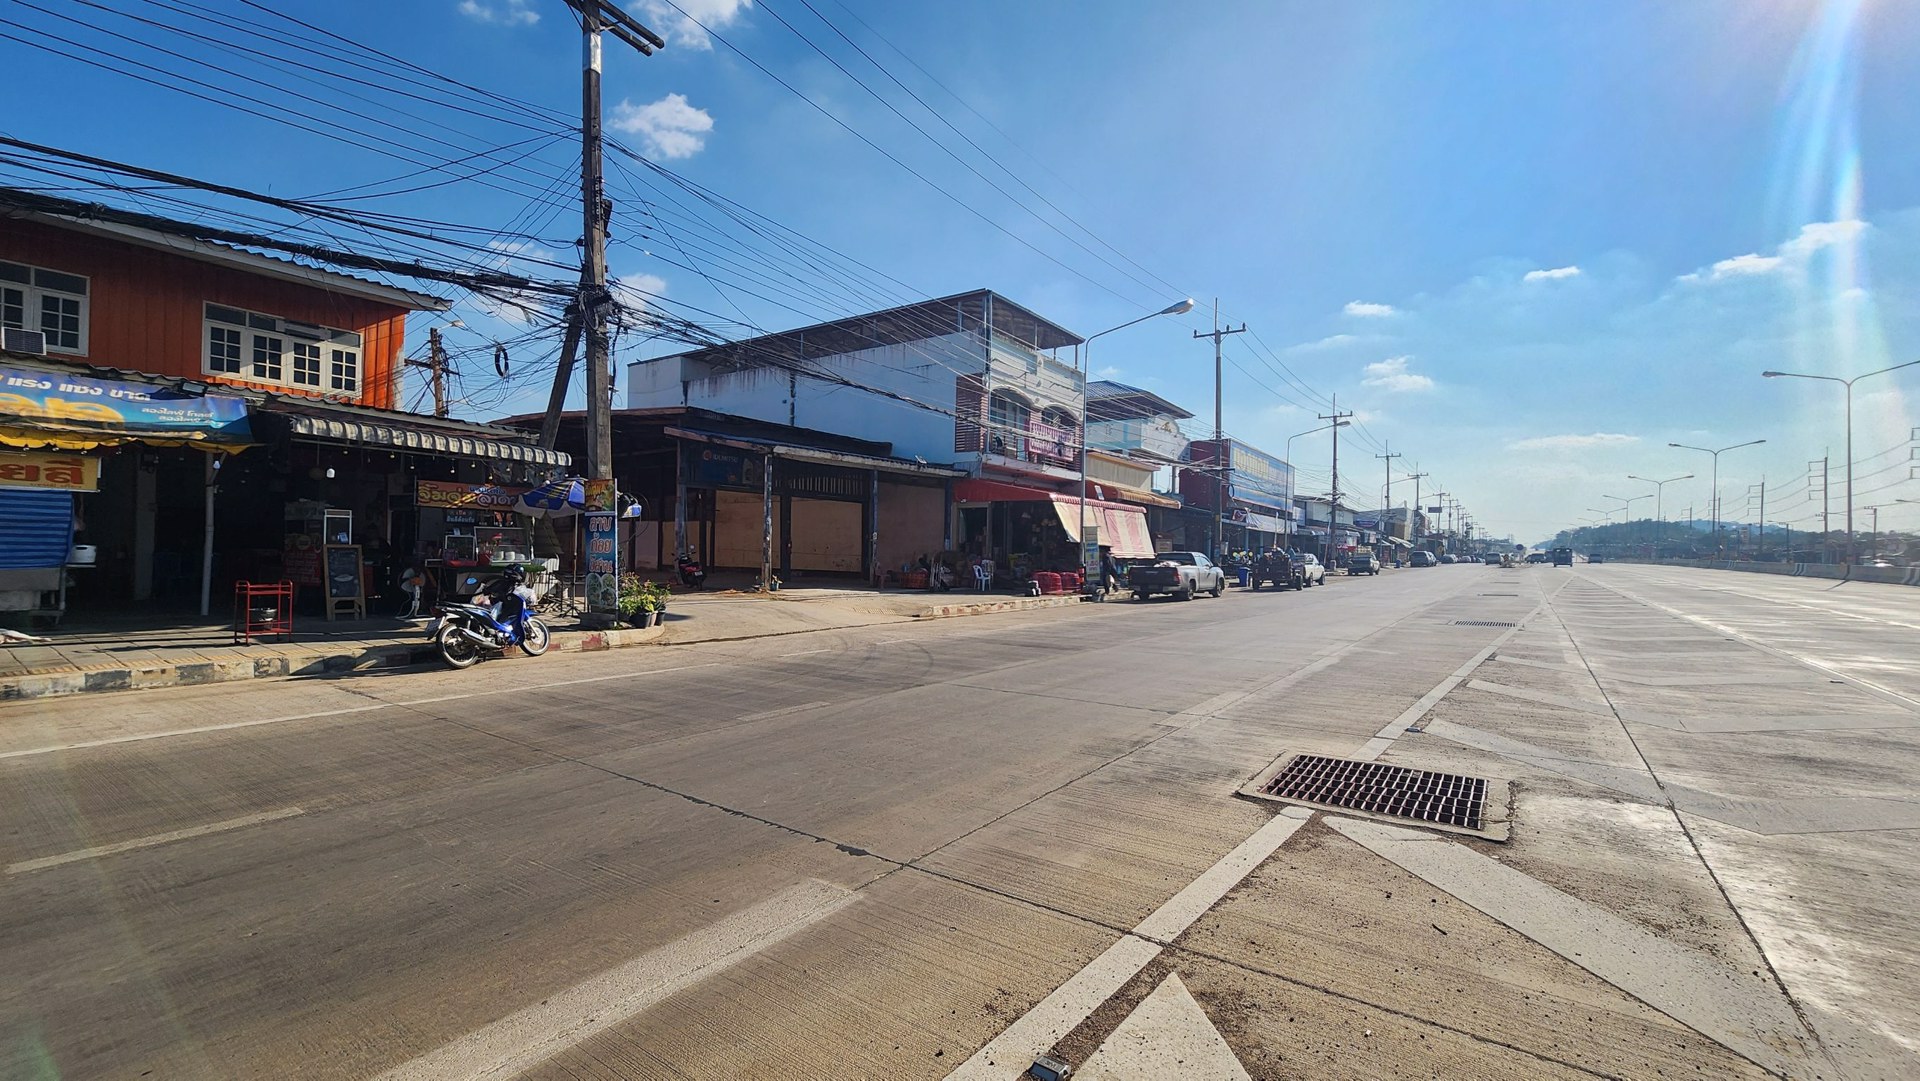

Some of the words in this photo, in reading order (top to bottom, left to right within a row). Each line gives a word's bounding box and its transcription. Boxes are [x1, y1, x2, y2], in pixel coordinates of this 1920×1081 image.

[7, 377, 52, 390] แรง
[589, 516, 613, 532] ลาบ
[590, 532, 613, 554] ก้อย
